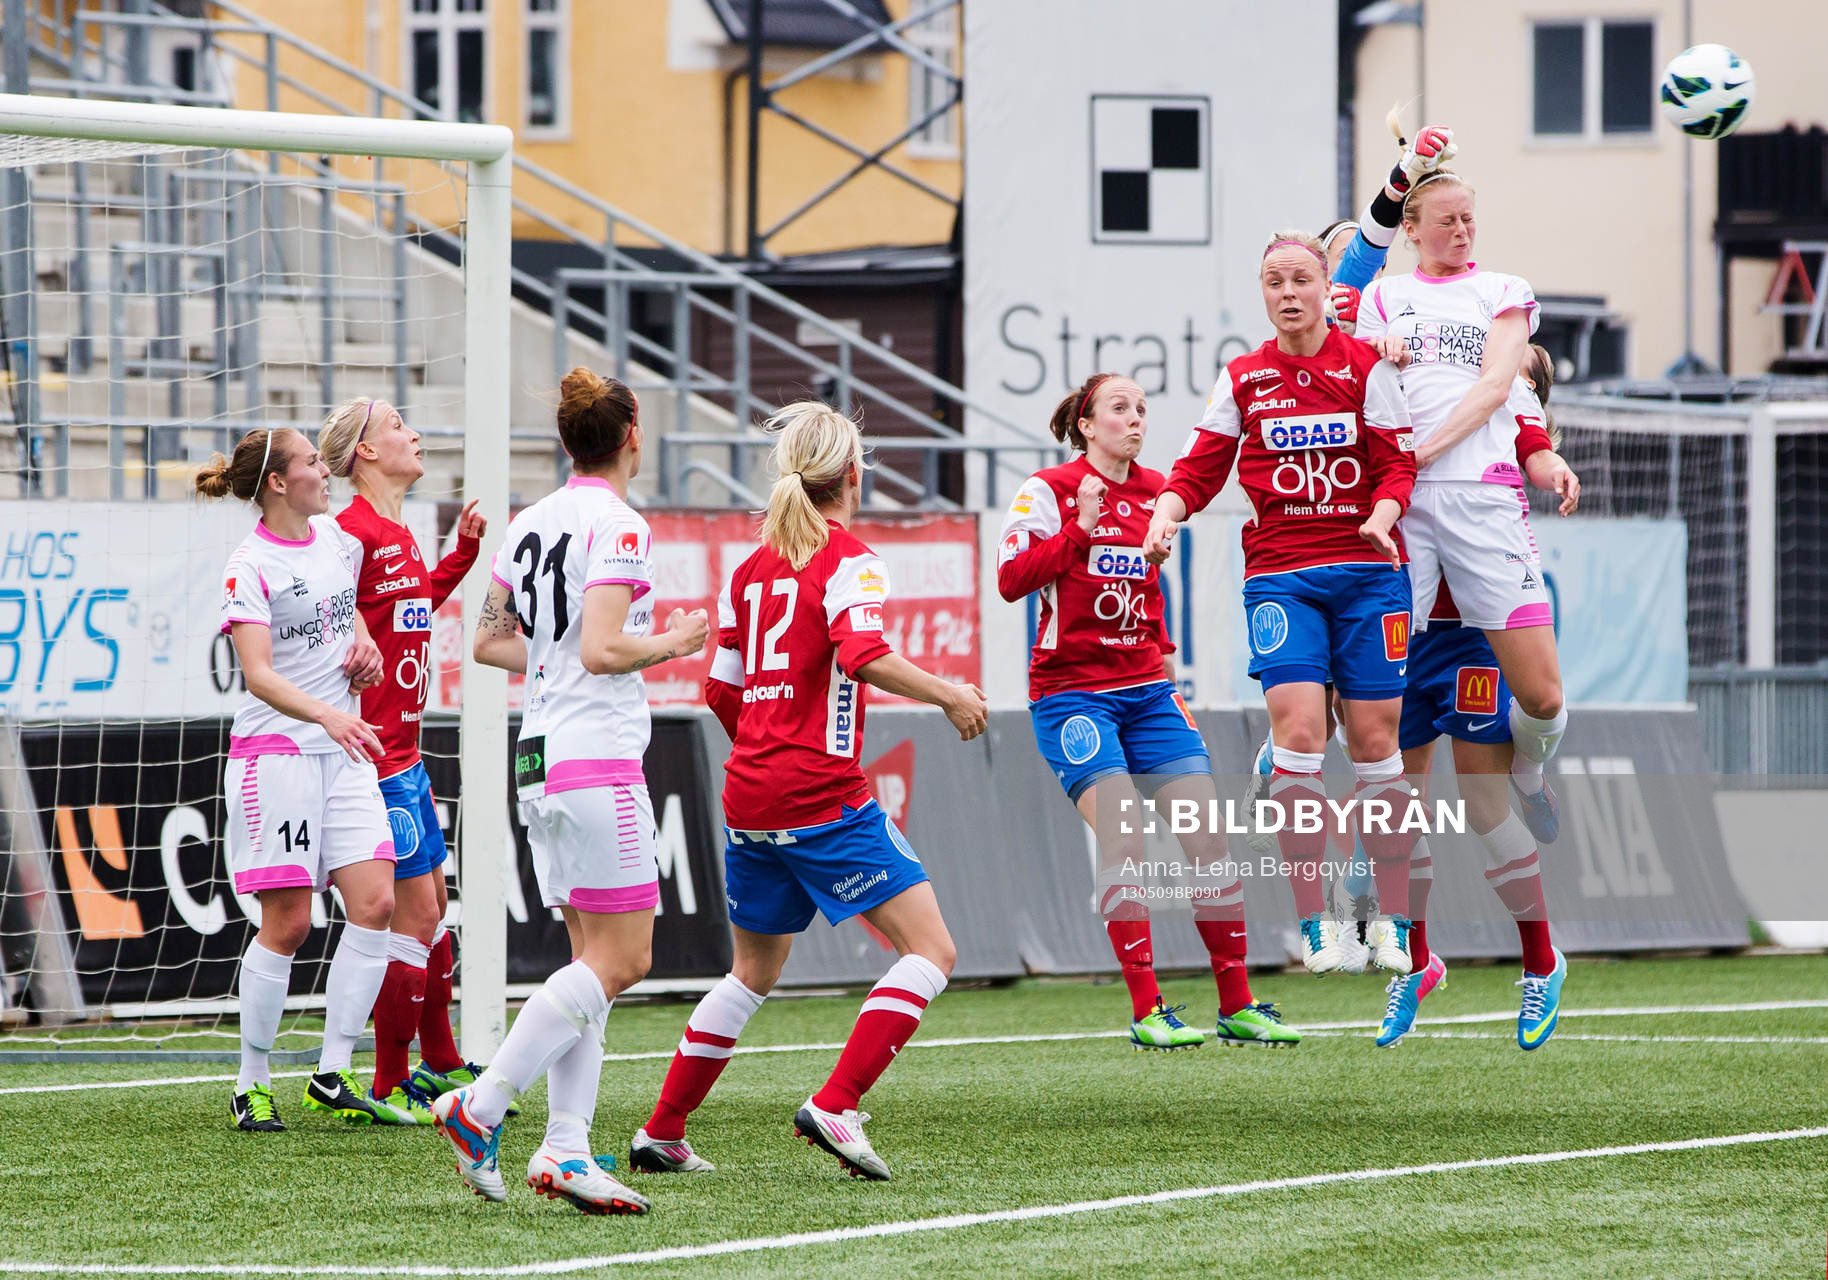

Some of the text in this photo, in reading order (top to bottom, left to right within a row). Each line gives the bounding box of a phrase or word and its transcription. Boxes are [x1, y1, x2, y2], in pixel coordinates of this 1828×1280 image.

[1247, 398, 1297, 416] stadium
[1270, 420, 1348, 449] ÖBAB
[1284, 504, 1313, 516] Hem
[1089, 526, 1123, 540] dium
[1, 531, 80, 579] HOS
[1096, 548, 1150, 577] ÖBA
[375, 576, 420, 594] stadium
[513, 531, 573, 642] 31
[402, 601, 432, 630] ÖB
[743, 577, 799, 675] 12
[278, 819, 311, 853] 14
